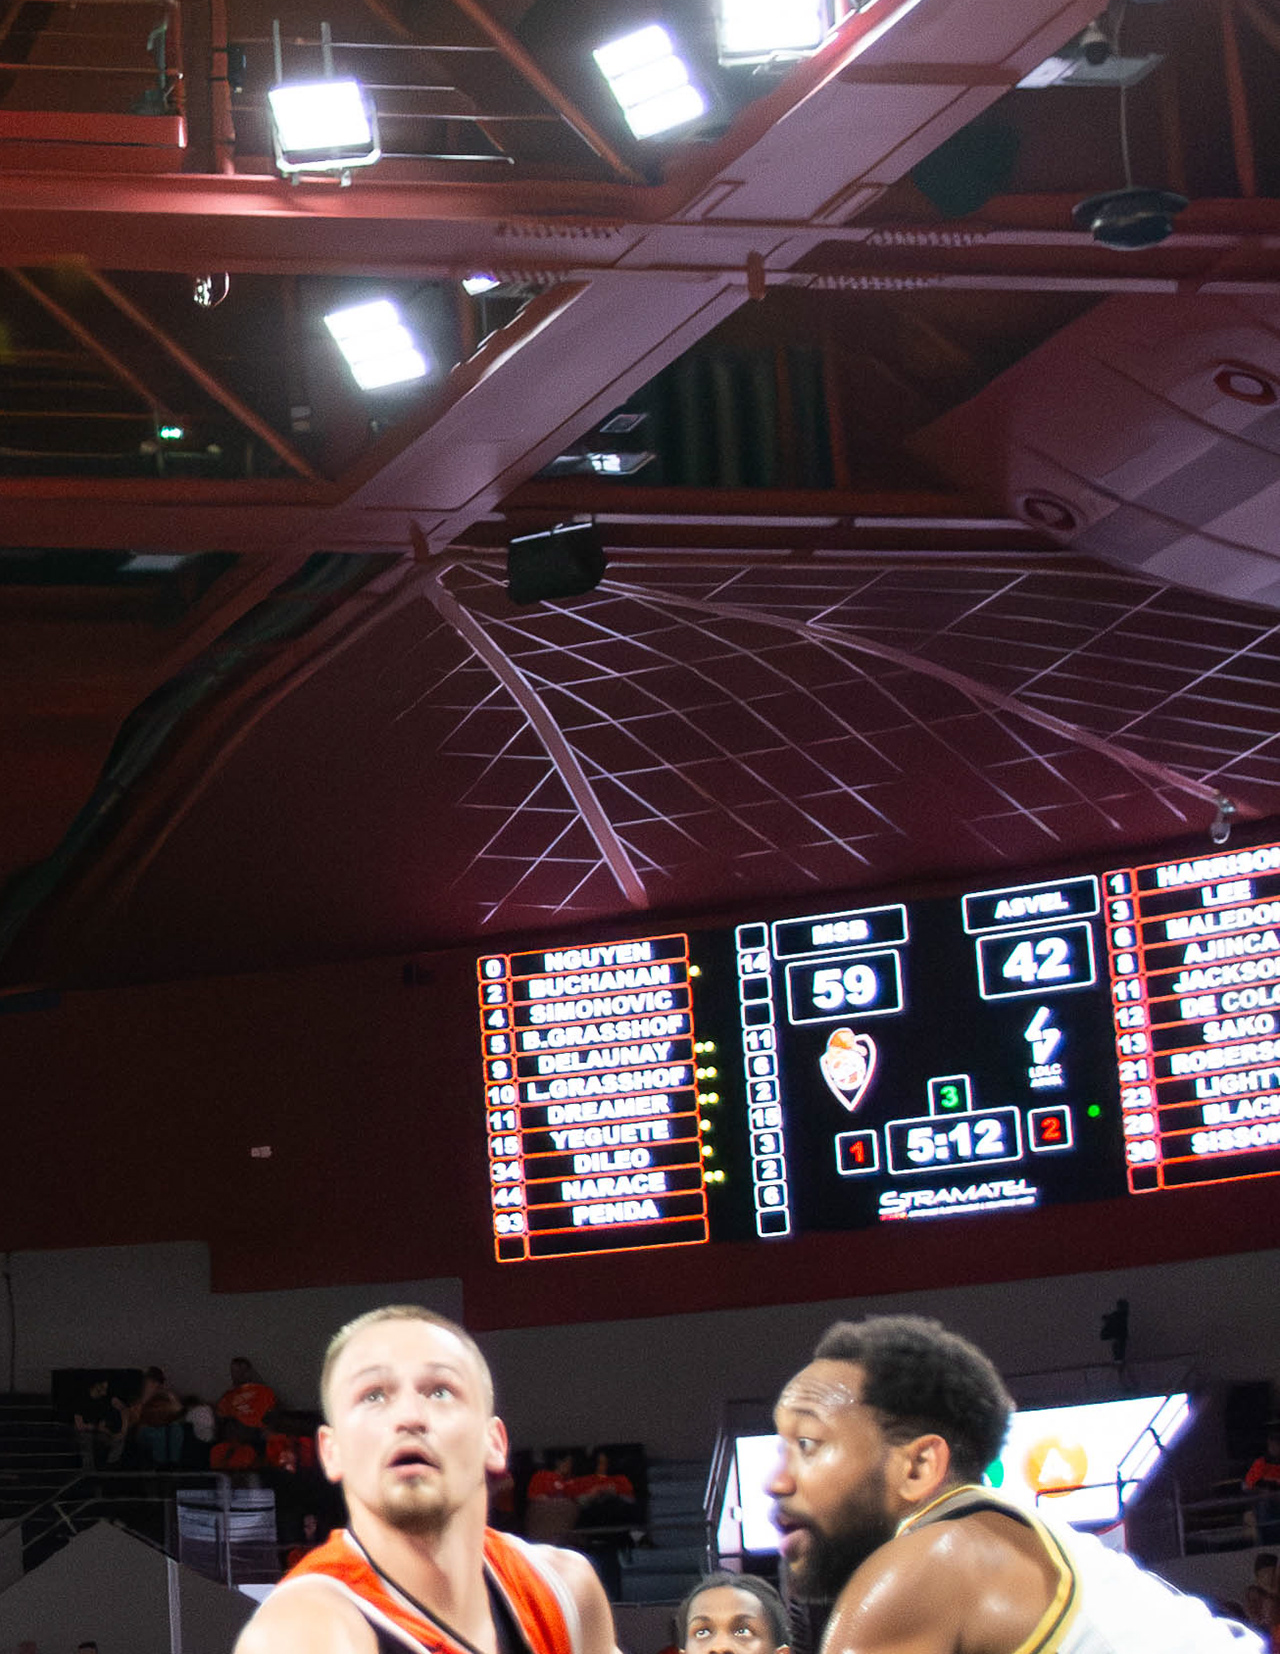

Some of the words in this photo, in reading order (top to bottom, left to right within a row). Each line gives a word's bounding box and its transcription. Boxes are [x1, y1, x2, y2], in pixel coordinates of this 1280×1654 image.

[1110, 874, 1126, 894] 1
[1113, 900, 1130, 921] 3
[1201, 880, 1252, 907] LEE
[994, 892, 1069, 919] ASVEL
[812, 919, 870, 945] MSB
[1114, 927, 1132, 947] 6
[486, 962, 500, 977] 0
[544, 942, 652, 972] NGUYEN
[740, 954, 768, 972] 14
[1002, 937, 1070, 982] 42
[488, 987, 503, 1002] 2
[529, 964, 670, 998] BUCHANAN
[812, 965, 878, 1009] 59
[1114, 980, 1141, 999] 11
[489, 1012, 505, 1028] 4
[529, 991, 673, 1024] SIMONOVIC
[1116, 1007, 1145, 1027] 12
[1180, 995, 1217, 1020] DE
[491, 1036, 506, 1052] 5
[523, 1015, 684, 1050] B.GRASSHOF
[747, 1031, 772, 1049] 11
[1118, 1033, 1146, 1054] 13
[1203, 1014, 1275, 1043] SAKO
[492, 1061, 507, 1078] 9
[538, 1042, 672, 1075] DELAUNAY
[1120, 1060, 1148, 1081] 21
[488, 1085, 515, 1104] 10
[527, 1067, 686, 1101] L.GRASSHOF
[754, 1083, 770, 1100] 2
[941, 1086, 959, 1108] 3
[1122, 1086, 1152, 1108] 23
[490, 1111, 516, 1130] 11
[547, 1095, 670, 1125] DREAMER
[1042, 1117, 1060, 1140] 2
[491, 1137, 518, 1155] 15
[550, 1120, 669, 1150] YEGUETE
[758, 1135, 775, 1151] 3
[850, 1141, 864, 1162] 1
[907, 1118, 1003, 1164] 5:12
[492, 1162, 520, 1181] 34
[573, 1148, 650, 1173] DILEO
[761, 1160, 778, 1177] 2
[494, 1187, 523, 1206] 44
[561, 1173, 666, 1201] NARACE
[878, 1178, 1037, 1216] STRAMATEL
[495, 1212, 525, 1233] 93
[573, 1199, 659, 1226] PENDA
